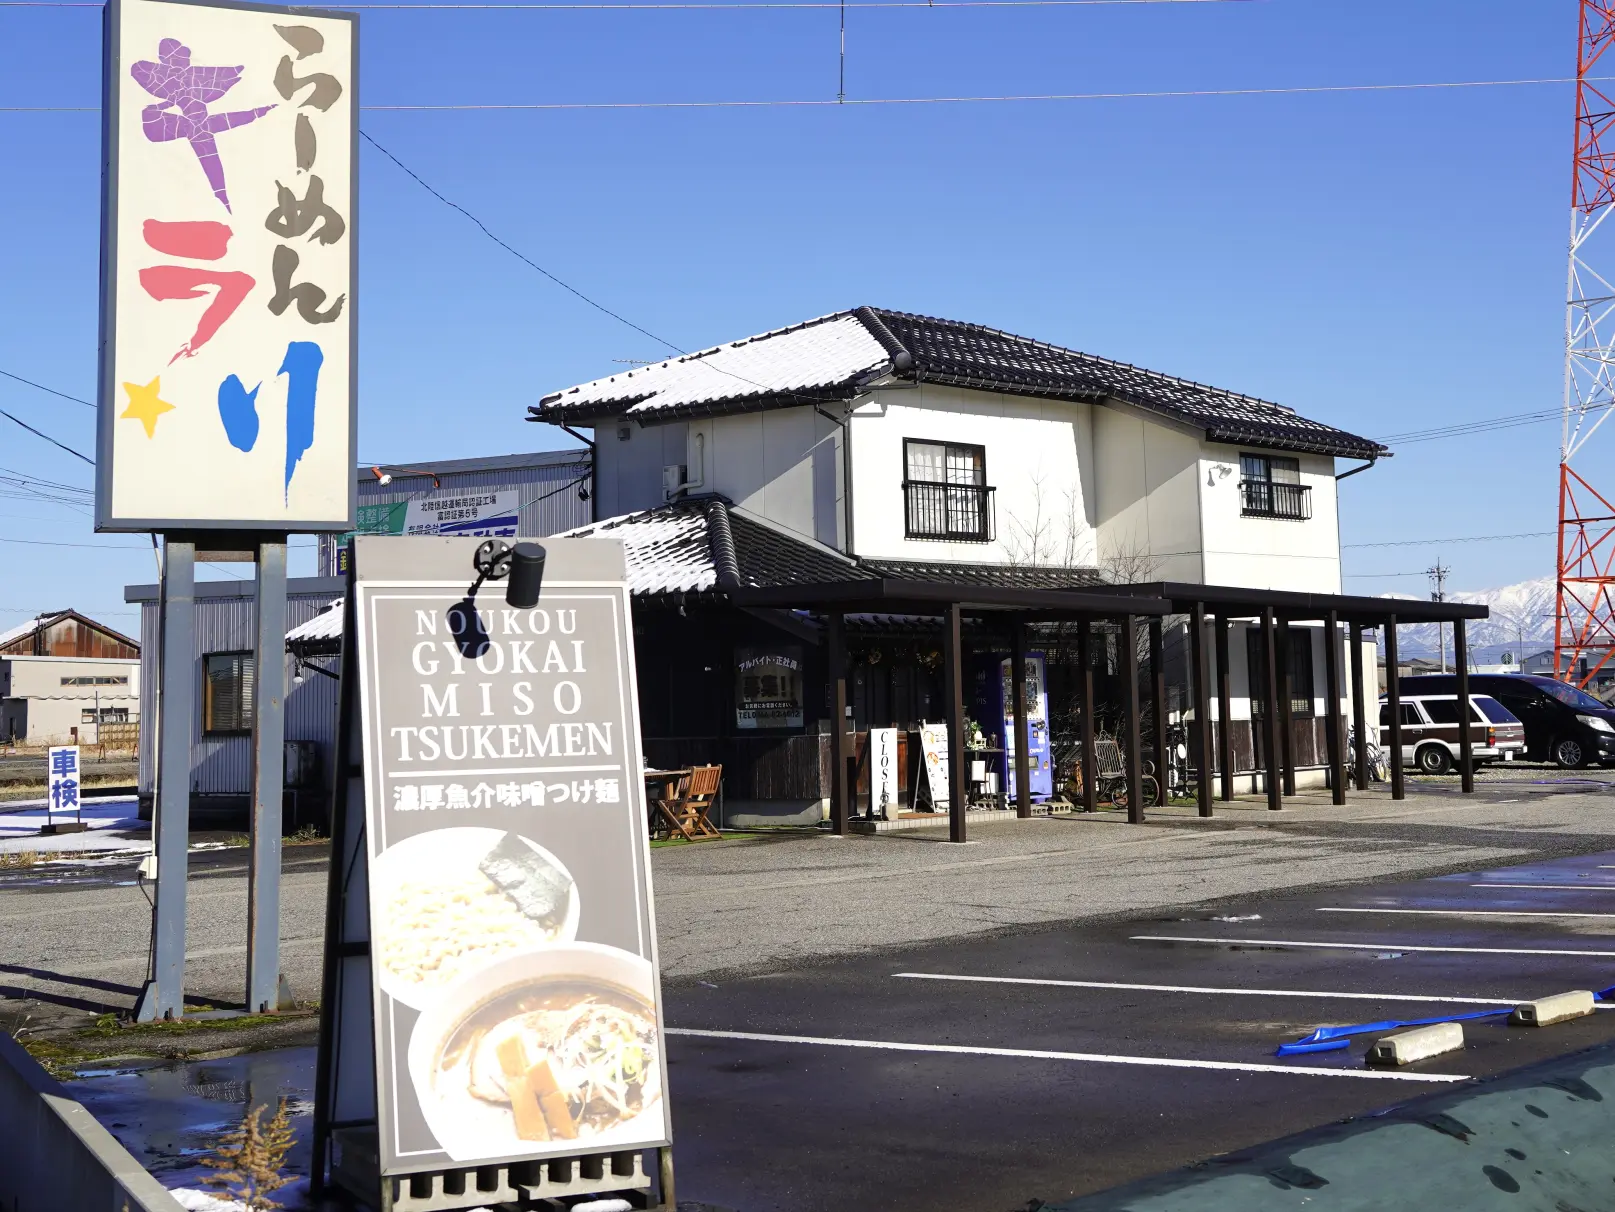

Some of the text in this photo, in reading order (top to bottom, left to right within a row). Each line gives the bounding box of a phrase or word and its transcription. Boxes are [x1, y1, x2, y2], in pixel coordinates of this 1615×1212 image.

[265, 24, 346, 324] らーめん
[416, 609, 577, 635] NOUKOU
[412, 640, 587, 676] GYOKAI
[420, 680, 583, 718] MISO
[390, 721, 613, 762] TSUKEMEN
[51, 749, 79, 809] 車検
[393, 778, 620, 812] 濃厚魚介味噌つけ麺
